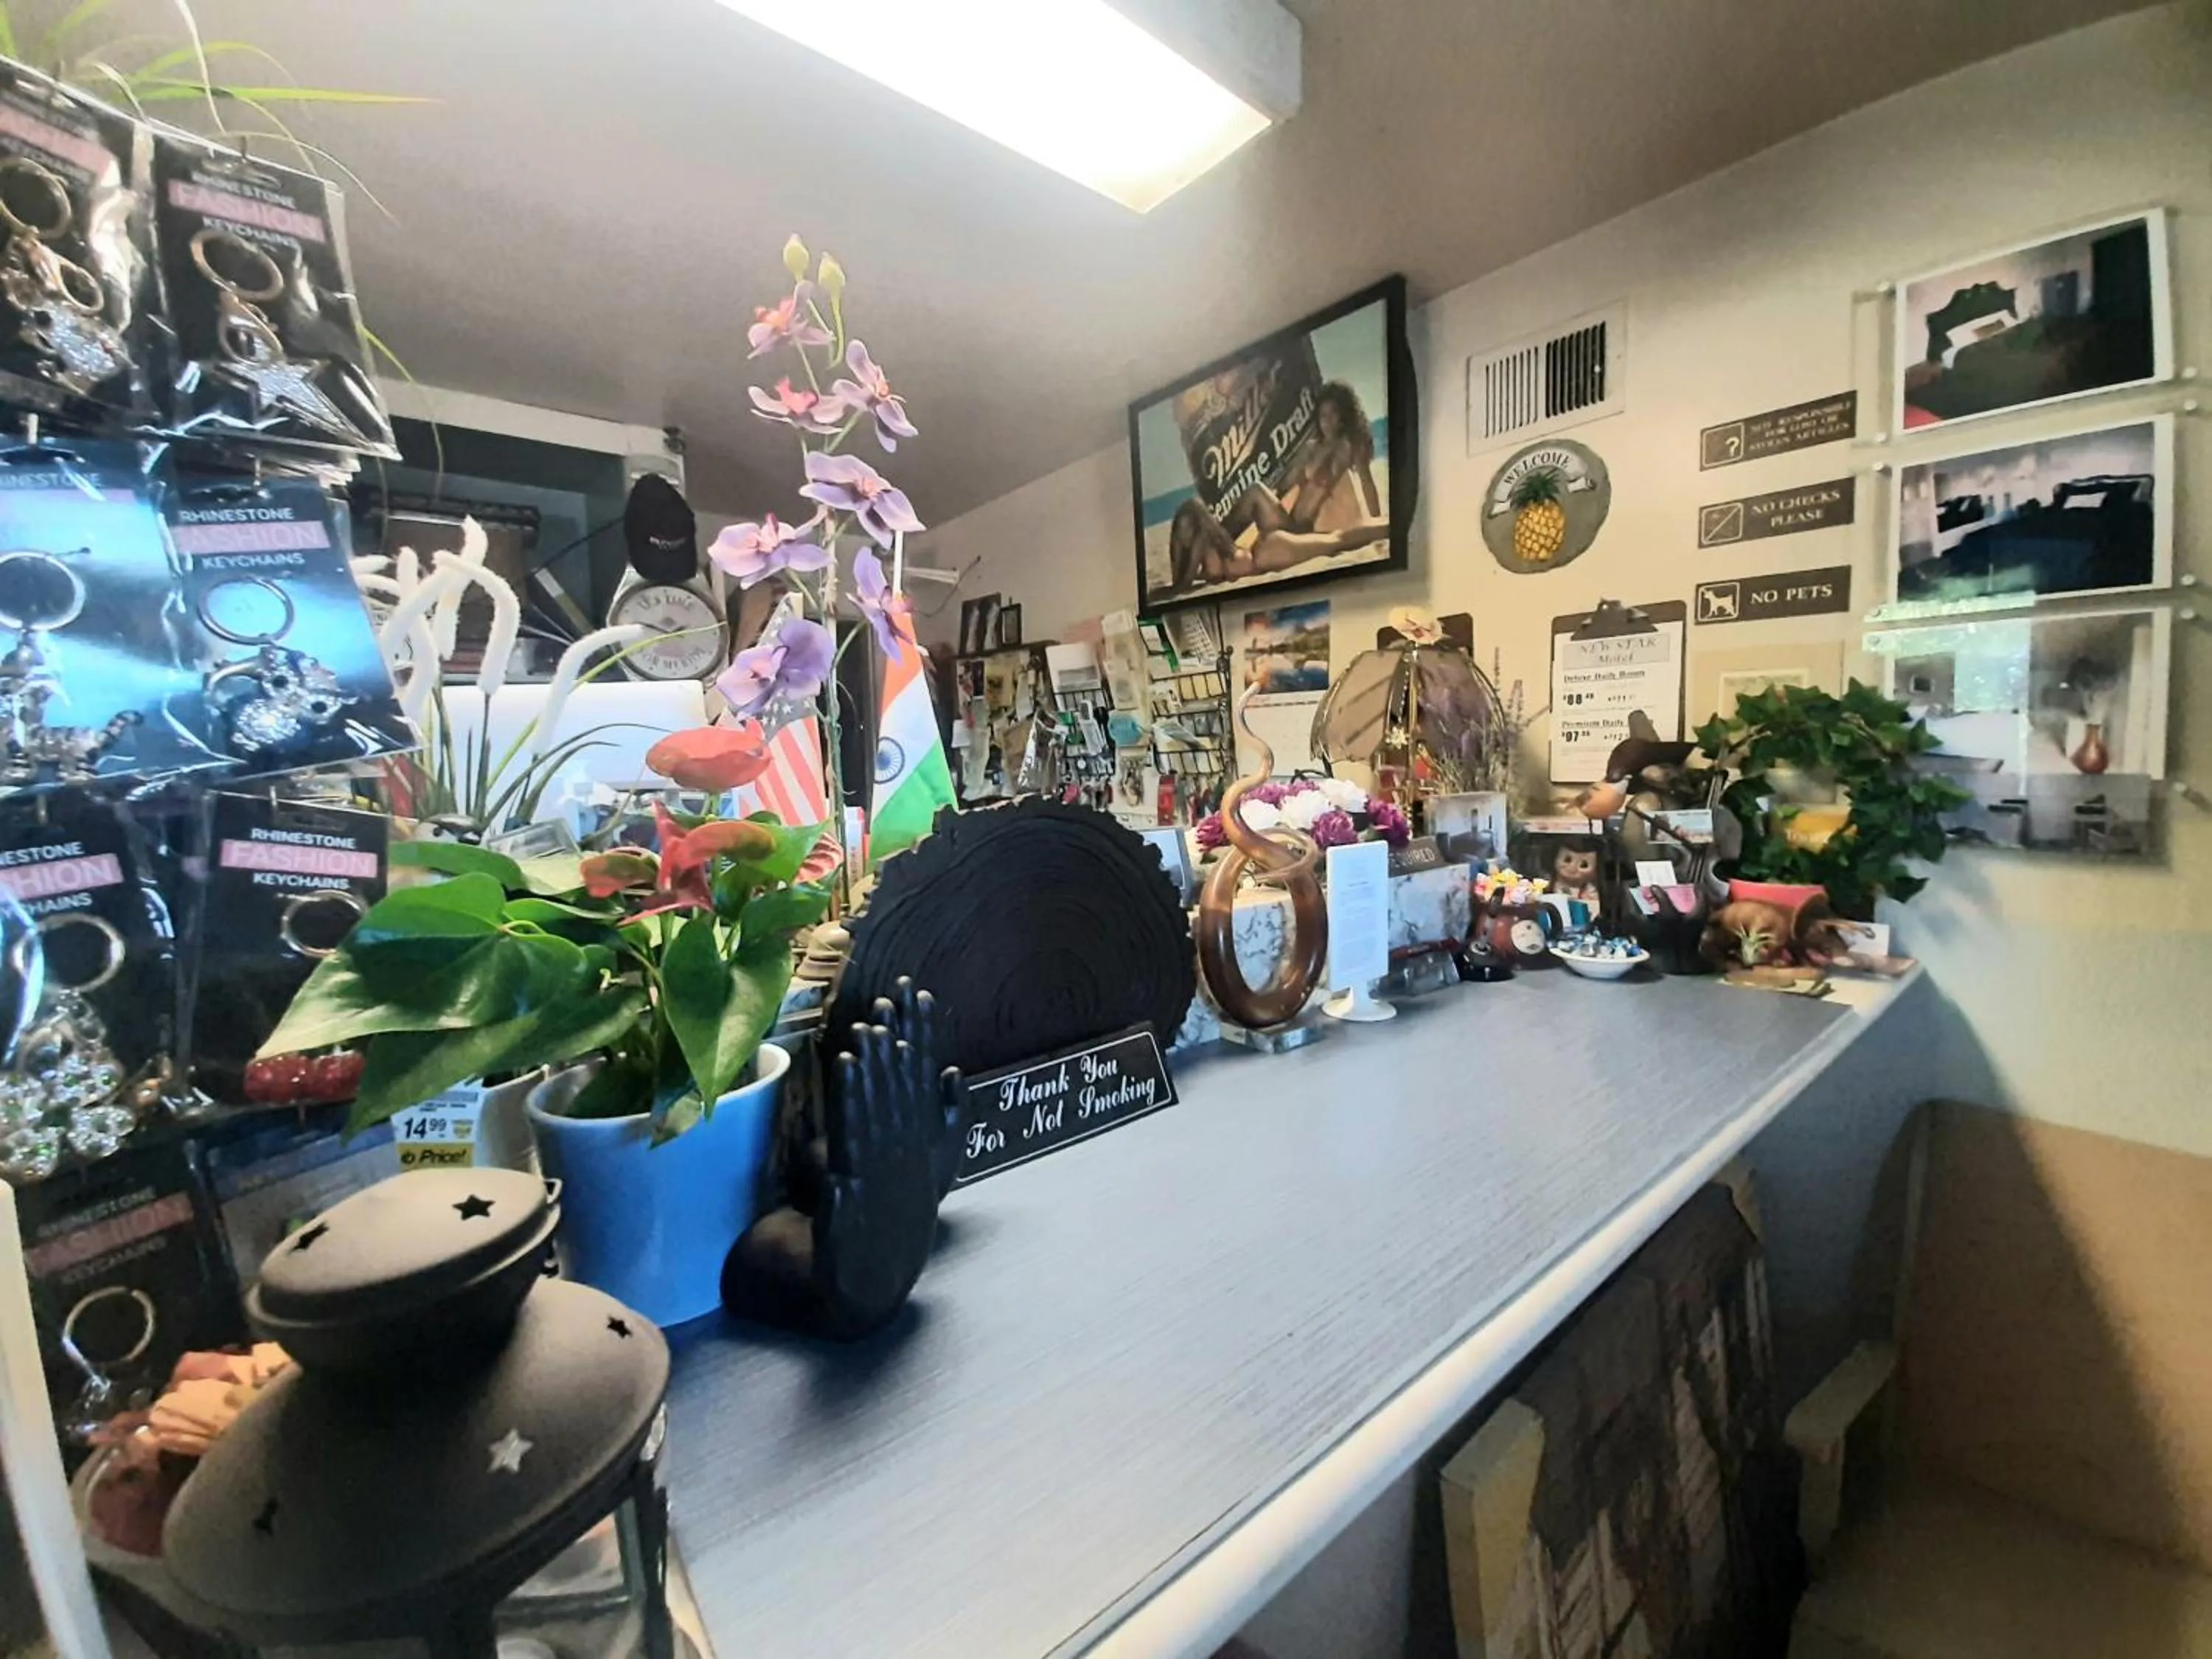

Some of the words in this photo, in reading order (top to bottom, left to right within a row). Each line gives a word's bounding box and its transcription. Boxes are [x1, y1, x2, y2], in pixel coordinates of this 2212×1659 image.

[1269, 386, 1315, 459] Draft
[1504, 452, 1570, 484] WELCOME
[1750, 501, 1775, 515] NO
[1779, 490, 1841, 509] CHECKS
[178, 507, 295, 522] RHINESTONE
[1770, 509, 1825, 527] PLEASE
[179, 523, 320, 552] ASHION
[201, 552, 306, 570] KEYCHAINS
[1750, 590, 1778, 605] NO
[1785, 583, 1834, 602] PETS
[250, 828, 358, 849] RHINESTONE
[232, 843, 369, 875] FASHION
[252, 873, 350, 890] KEYCHAINS
[999, 1065, 1069, 1111] Thank
[1079, 1054, 1118, 1083] You
[966, 1121, 1006, 1158] For
[1023, 1099, 1064, 1138] Not
[1078, 1074, 1155, 1119] Smoking
[419, 1147, 467, 1164] Price!
